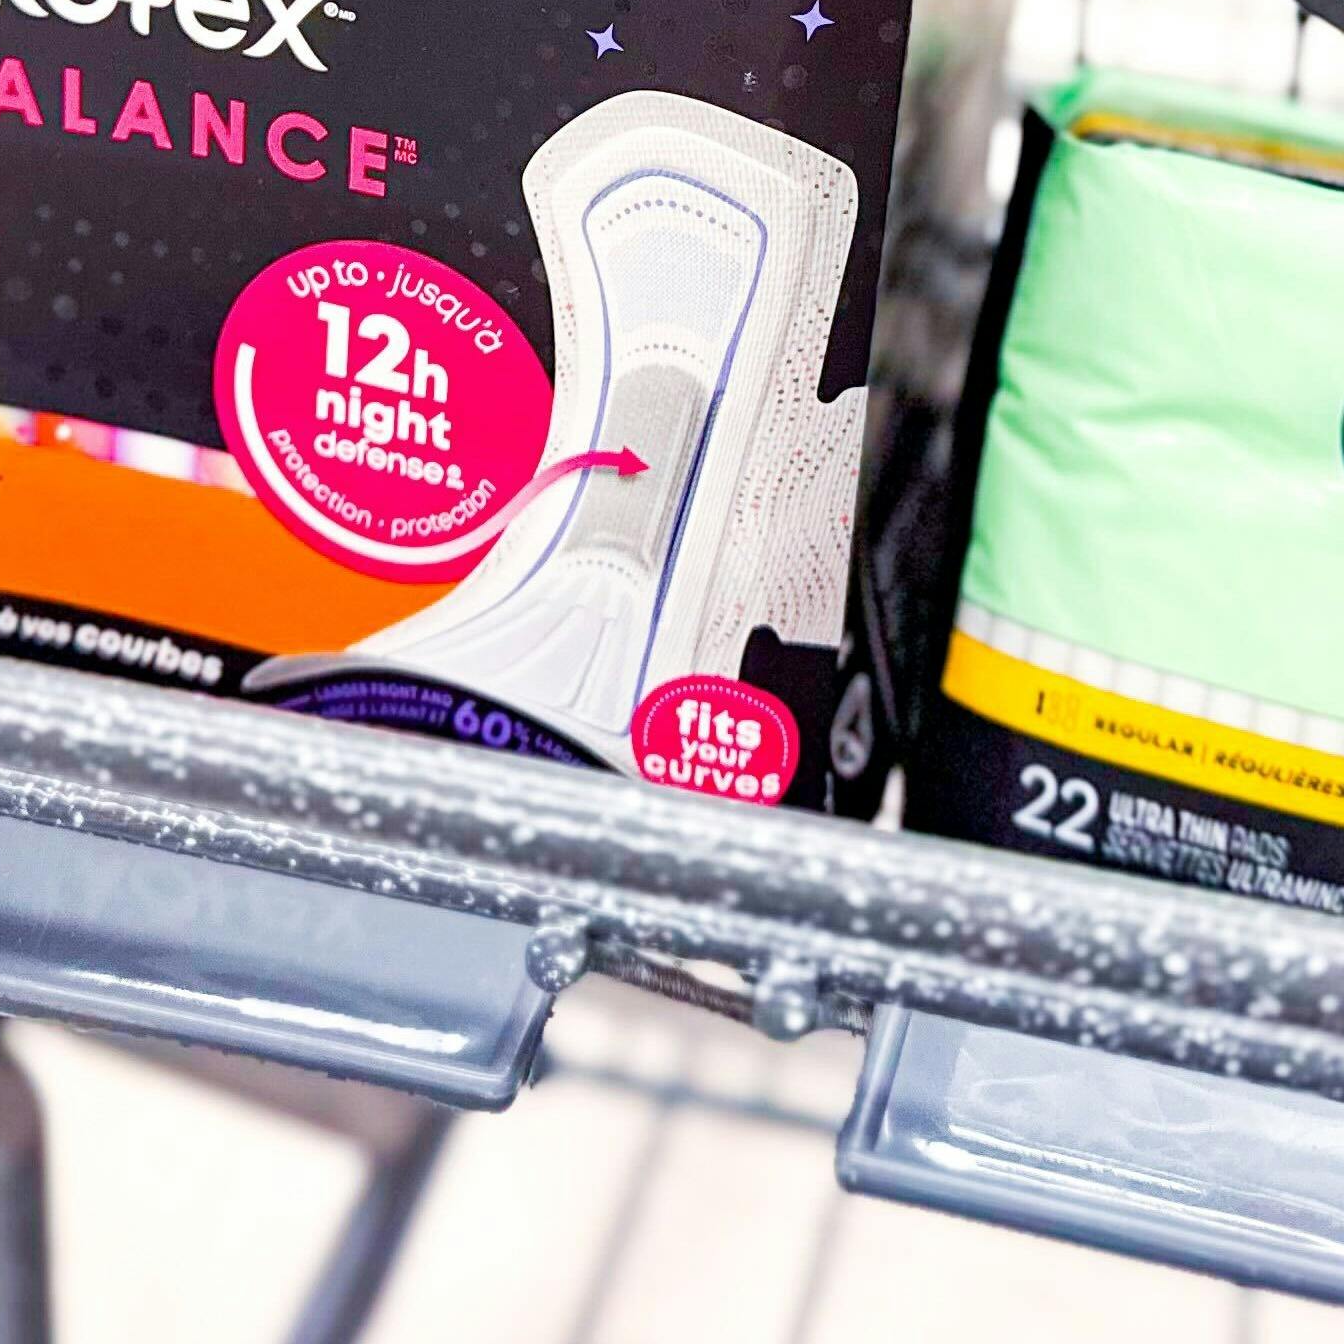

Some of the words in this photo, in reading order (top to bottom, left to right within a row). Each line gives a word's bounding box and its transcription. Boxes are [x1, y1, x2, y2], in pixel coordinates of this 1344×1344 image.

[287, 265, 330, 299] up
[332, 259, 368, 286] to
[385, 263, 503, 354] jusqu'à
[317, 301, 448, 403] 12h
[315, 385, 452, 451] night
[267, 428, 373, 529] protection
[391, 478, 497, 539] protection
[313, 429, 444, 486] defense
[20, 614, 72, 644] vos
[73, 622, 224, 686] courbes
[676, 699, 761, 751] fits
[680, 736, 752, 770] your
[1093, 715, 1195, 757] REGULAR
[643, 753, 780, 798] curves
[1012, 763, 1100, 852] 22
[1109, 791, 1175, 838] ULTRA
[1177, 809, 1229, 851] THIN
